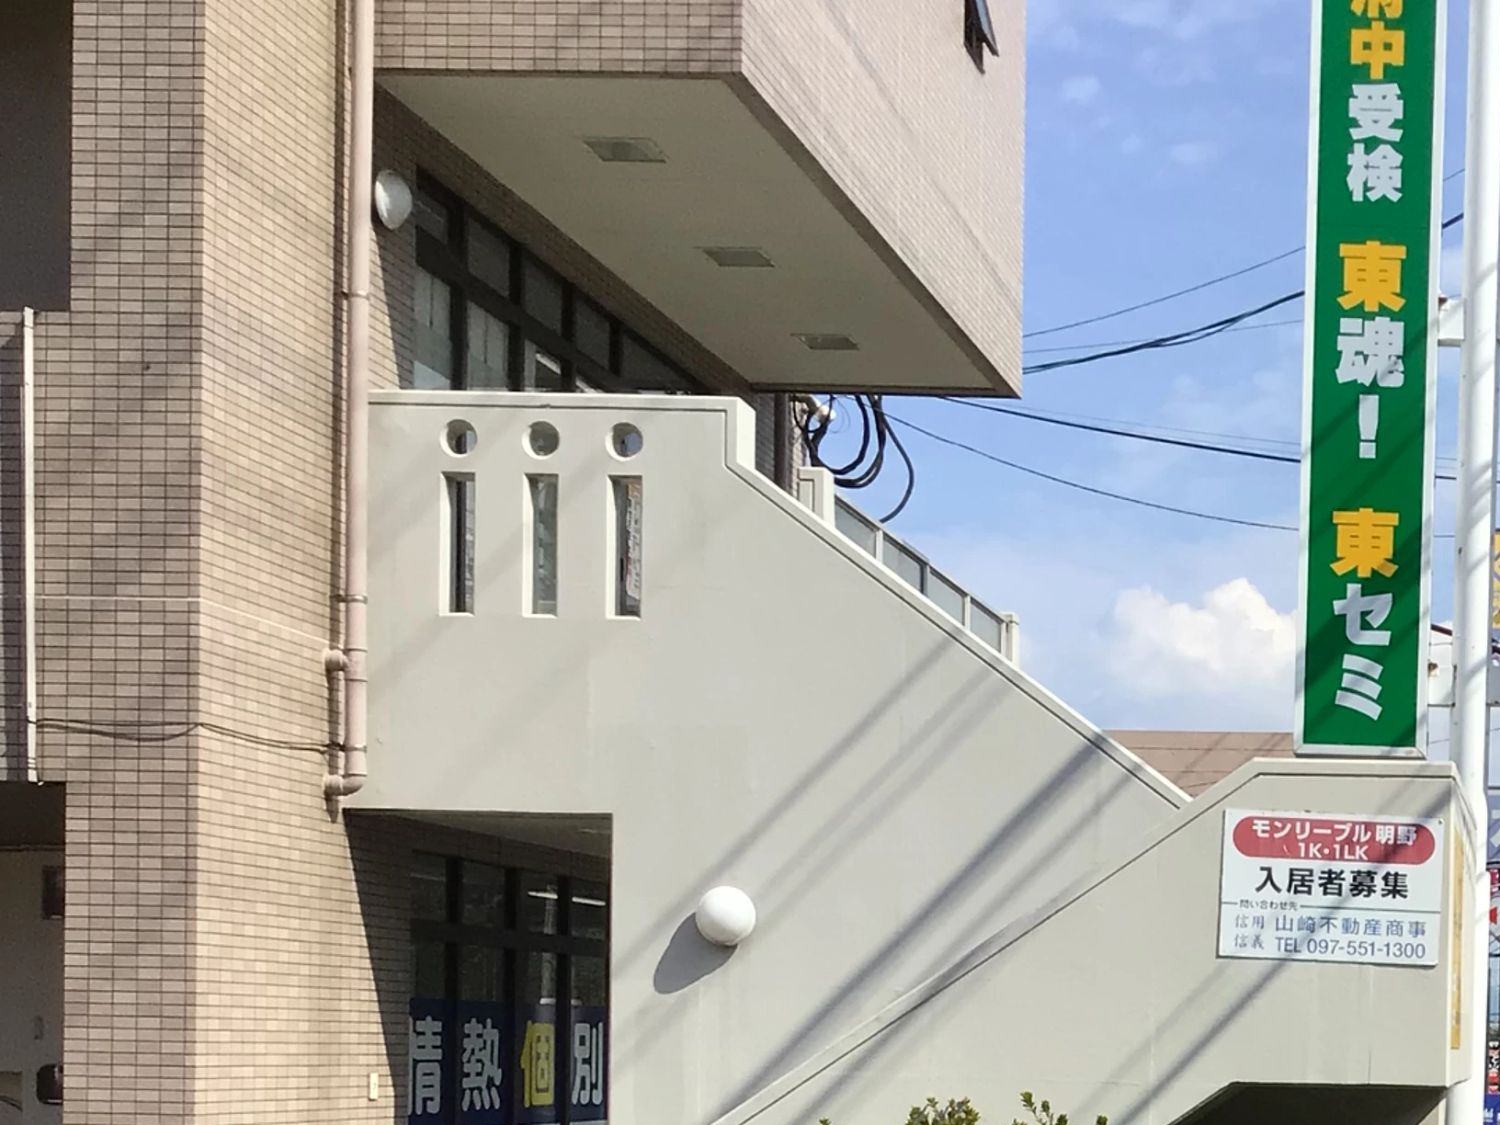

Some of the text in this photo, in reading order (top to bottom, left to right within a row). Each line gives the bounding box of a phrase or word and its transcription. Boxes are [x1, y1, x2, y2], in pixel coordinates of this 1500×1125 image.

[1330, 507, 1400, 721] 東セミ
[1252, 818, 1417, 846] モンリーブル明野
[1255, 866, 1409, 899] 入居者募集
[1239, 899, 1298, 911] 問い合わせ先
[1275, 936, 1301, 953] TEL
[1306, 937, 1426, 959] 097-551-1300
[407, 1014, 604, 1118] 情熱個別
